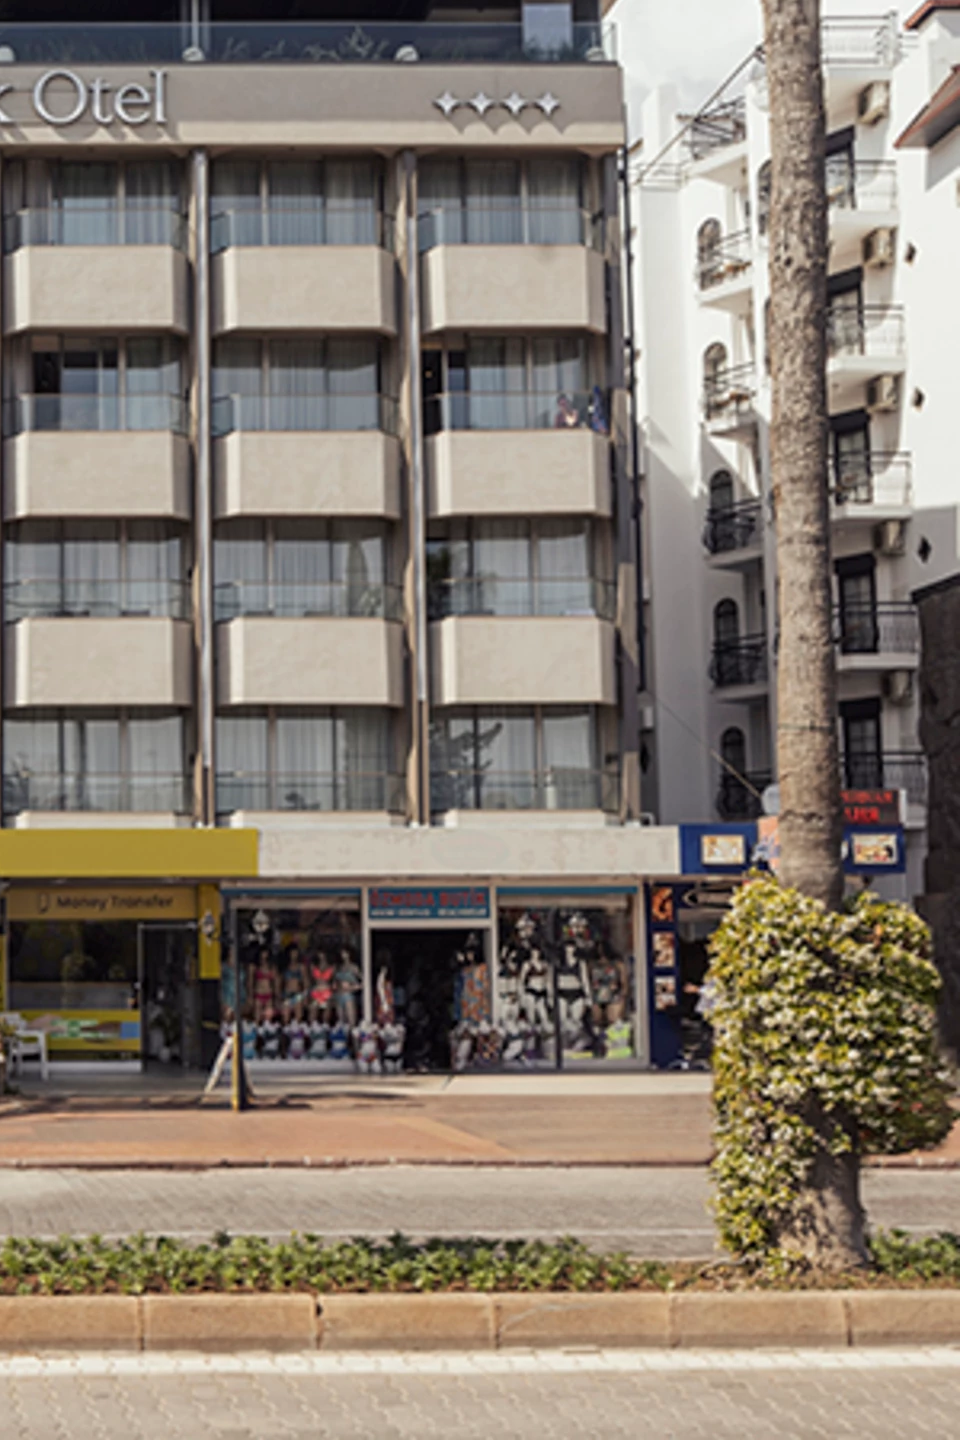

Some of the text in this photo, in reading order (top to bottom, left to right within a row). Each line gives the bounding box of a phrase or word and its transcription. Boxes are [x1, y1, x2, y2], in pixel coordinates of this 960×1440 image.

[34, 68, 168, 124] Otel
[56, 893, 174, 911] Money Transfer
